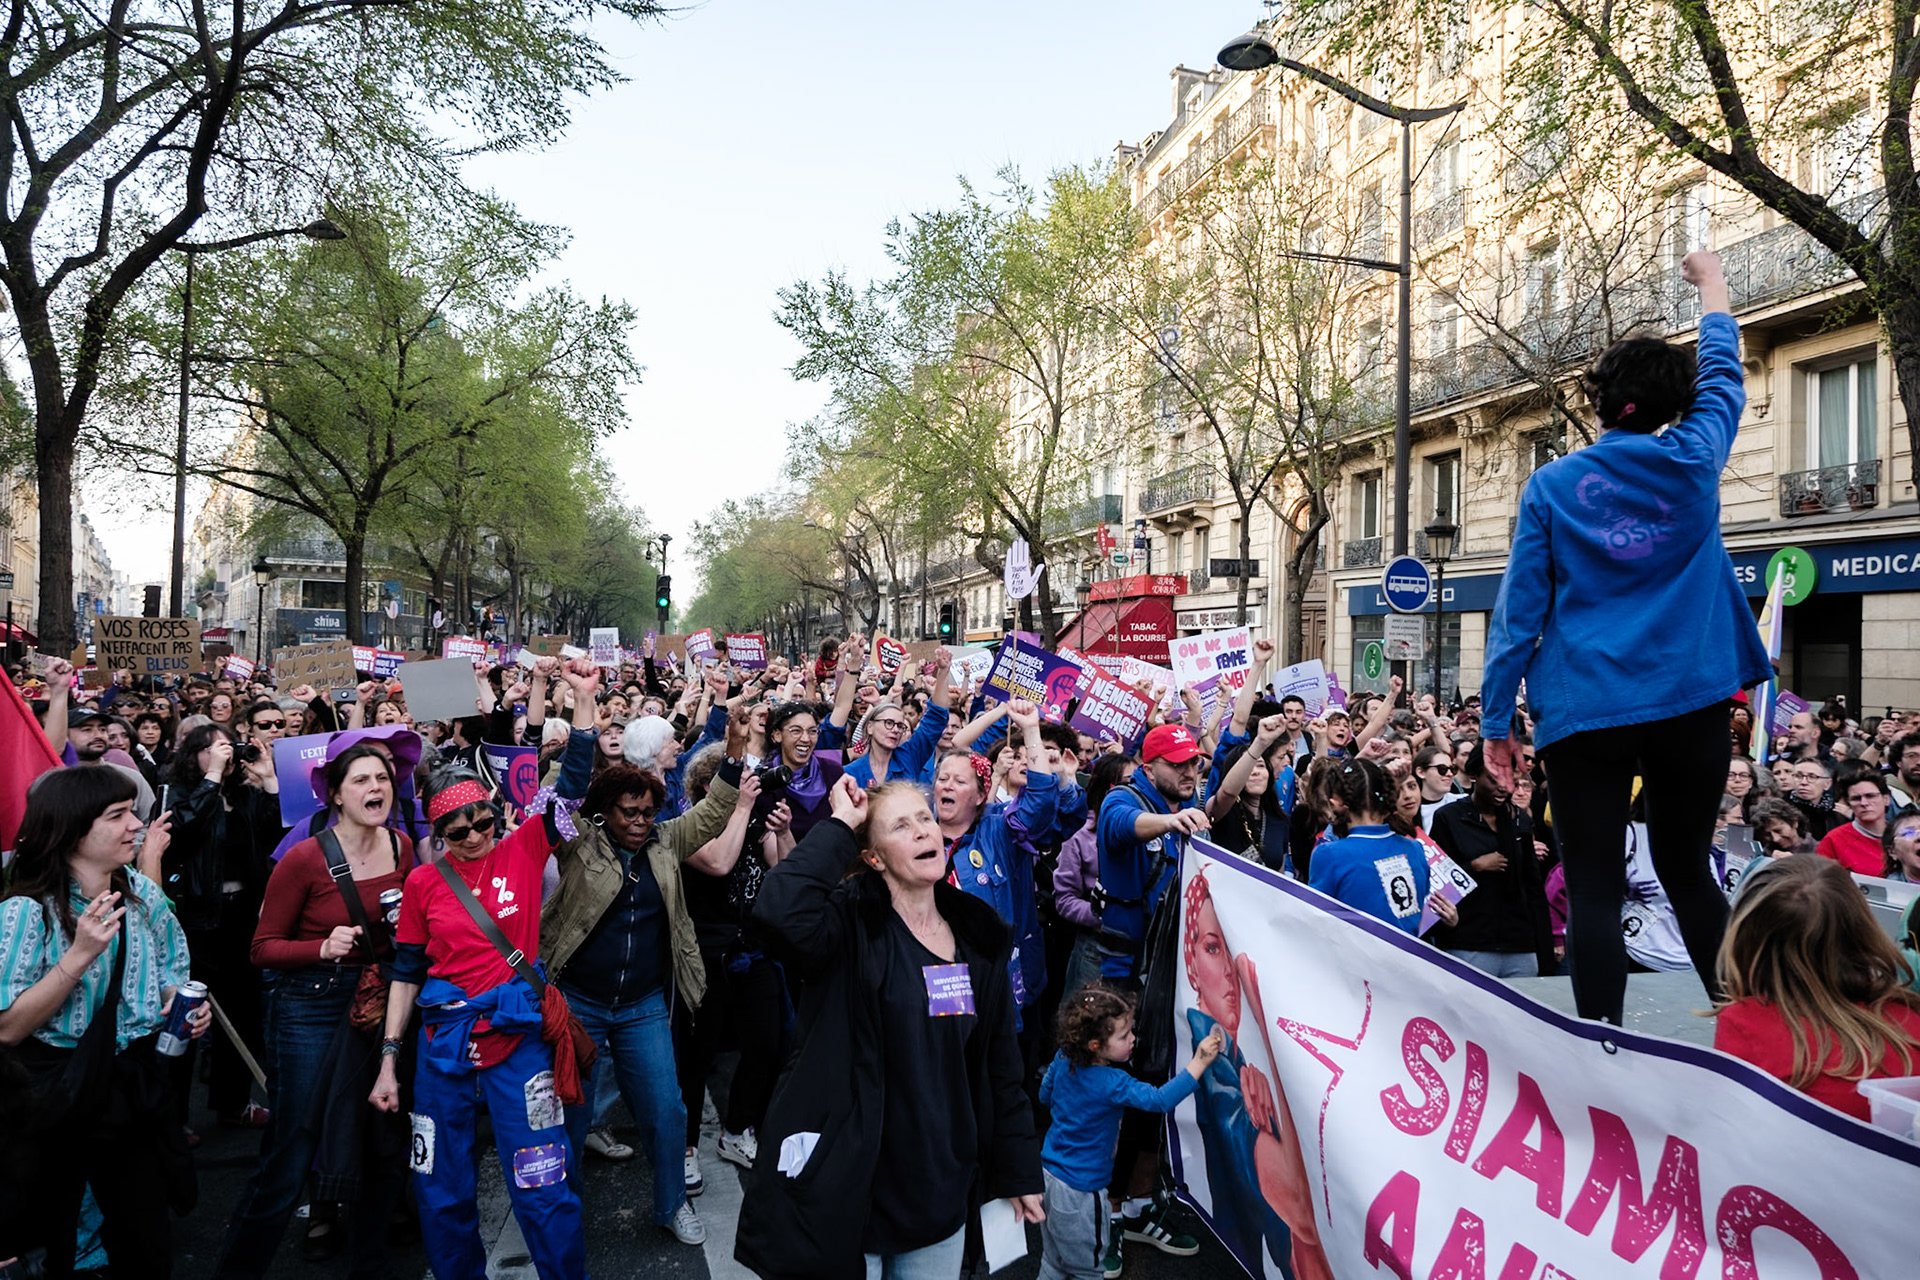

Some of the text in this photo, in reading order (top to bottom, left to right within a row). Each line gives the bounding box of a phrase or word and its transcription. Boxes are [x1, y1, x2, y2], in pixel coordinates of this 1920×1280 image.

[1212, 561, 1257, 575] HOTL
[1156, 577, 1177, 587] BAR
[1152, 585, 1180, 595] TABAC
[100, 619, 190, 639] VOS ROSES
[1130, 623, 1157, 631] TABAC
[1108, 634, 1166, 642] DE LA BOURSE
[101, 641, 193, 656] N'EFFACENT PAS
[1178, 642, 1198, 658] ON
[108, 656, 190, 671] NOS BLEUS
[1215, 649, 1247, 670] FEMME
[1122, 661, 1140, 676] RAS
[990, 675, 1009, 690] MAIS
[1090, 677, 1149, 723] NÉMÉSIS,
[497, 903, 519, 919] attac
[933, 976, 960, 986] SERVICES
[932, 992, 948, 1000] POUR
[1380, 1016, 1860, 1280] SIAMO
